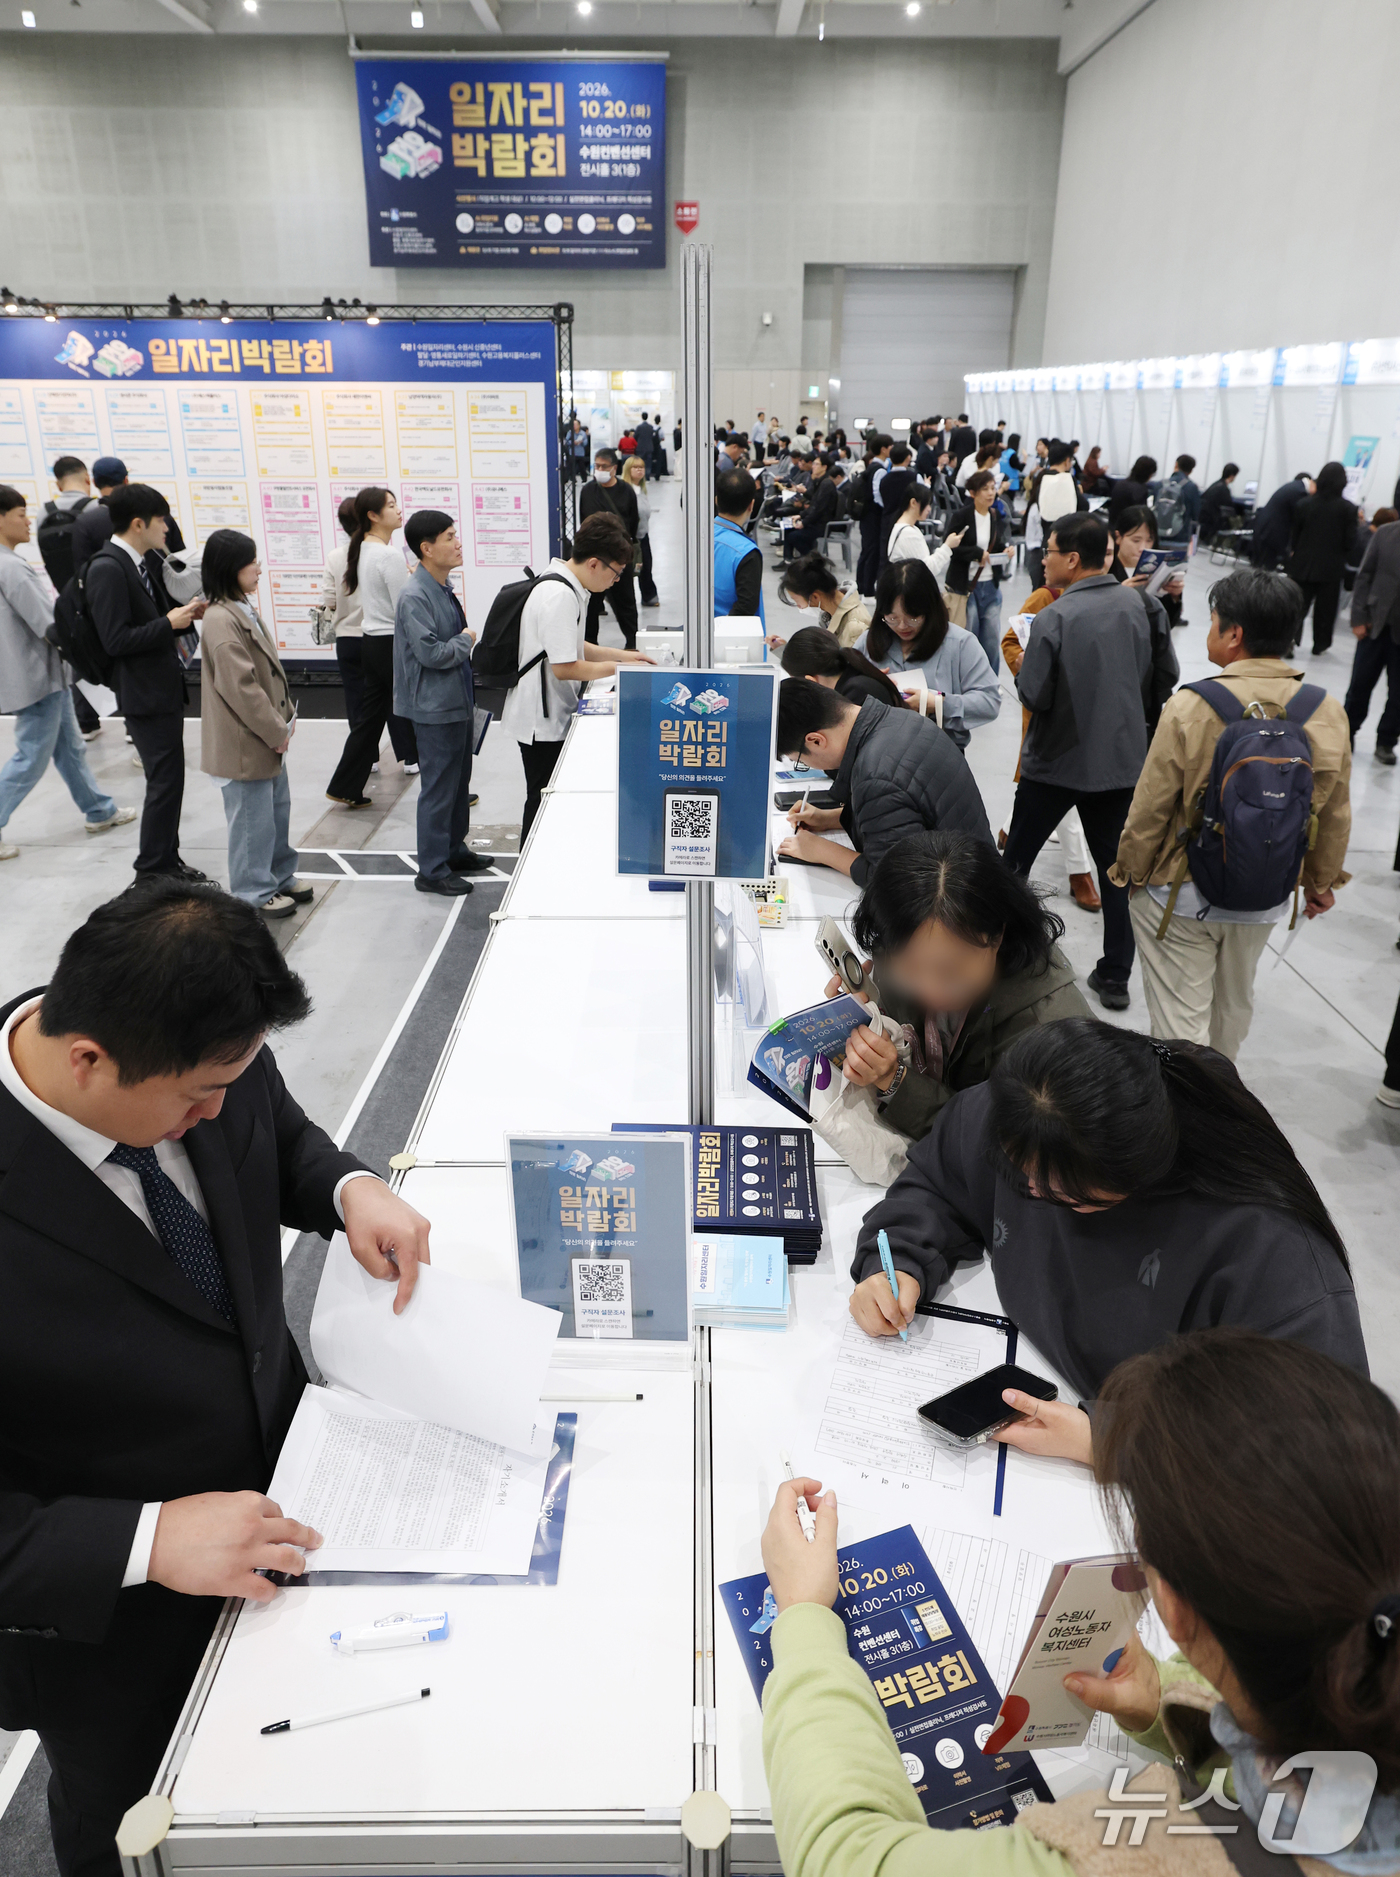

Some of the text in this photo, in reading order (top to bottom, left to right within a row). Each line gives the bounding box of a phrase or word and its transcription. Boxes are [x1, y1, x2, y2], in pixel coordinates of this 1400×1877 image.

[450, 82, 565, 127] 일자리
[579, 124, 652, 138] 14:00~17:00
[451, 133, 566, 178] 박람회
[148, 338, 334, 373] 일자리박람회
[659, 719, 728, 743] 일자리
[659, 744, 727, 768] 박람회
[696, 1132, 721, 1218] 일자리박람회
[558, 1185, 636, 1209] 일자리
[560, 1210, 637, 1233] 박람회
[700, 1244, 709, 1289] 수원일자리센터
[495, 1464, 513, 1506] 자기소개서
[844, 1580, 926, 1619] 14:00~17:00
[1055, 1609, 1096, 1623] 수원시
[853, 1624, 872, 1639] 수원
[858, 1629, 901, 1652] 컨벤션센터
[1048, 1621, 1112, 1638] 여성노동자
[1041, 1637, 1092, 1652] 복지센터
[873, 1649, 978, 1709] 박람회
